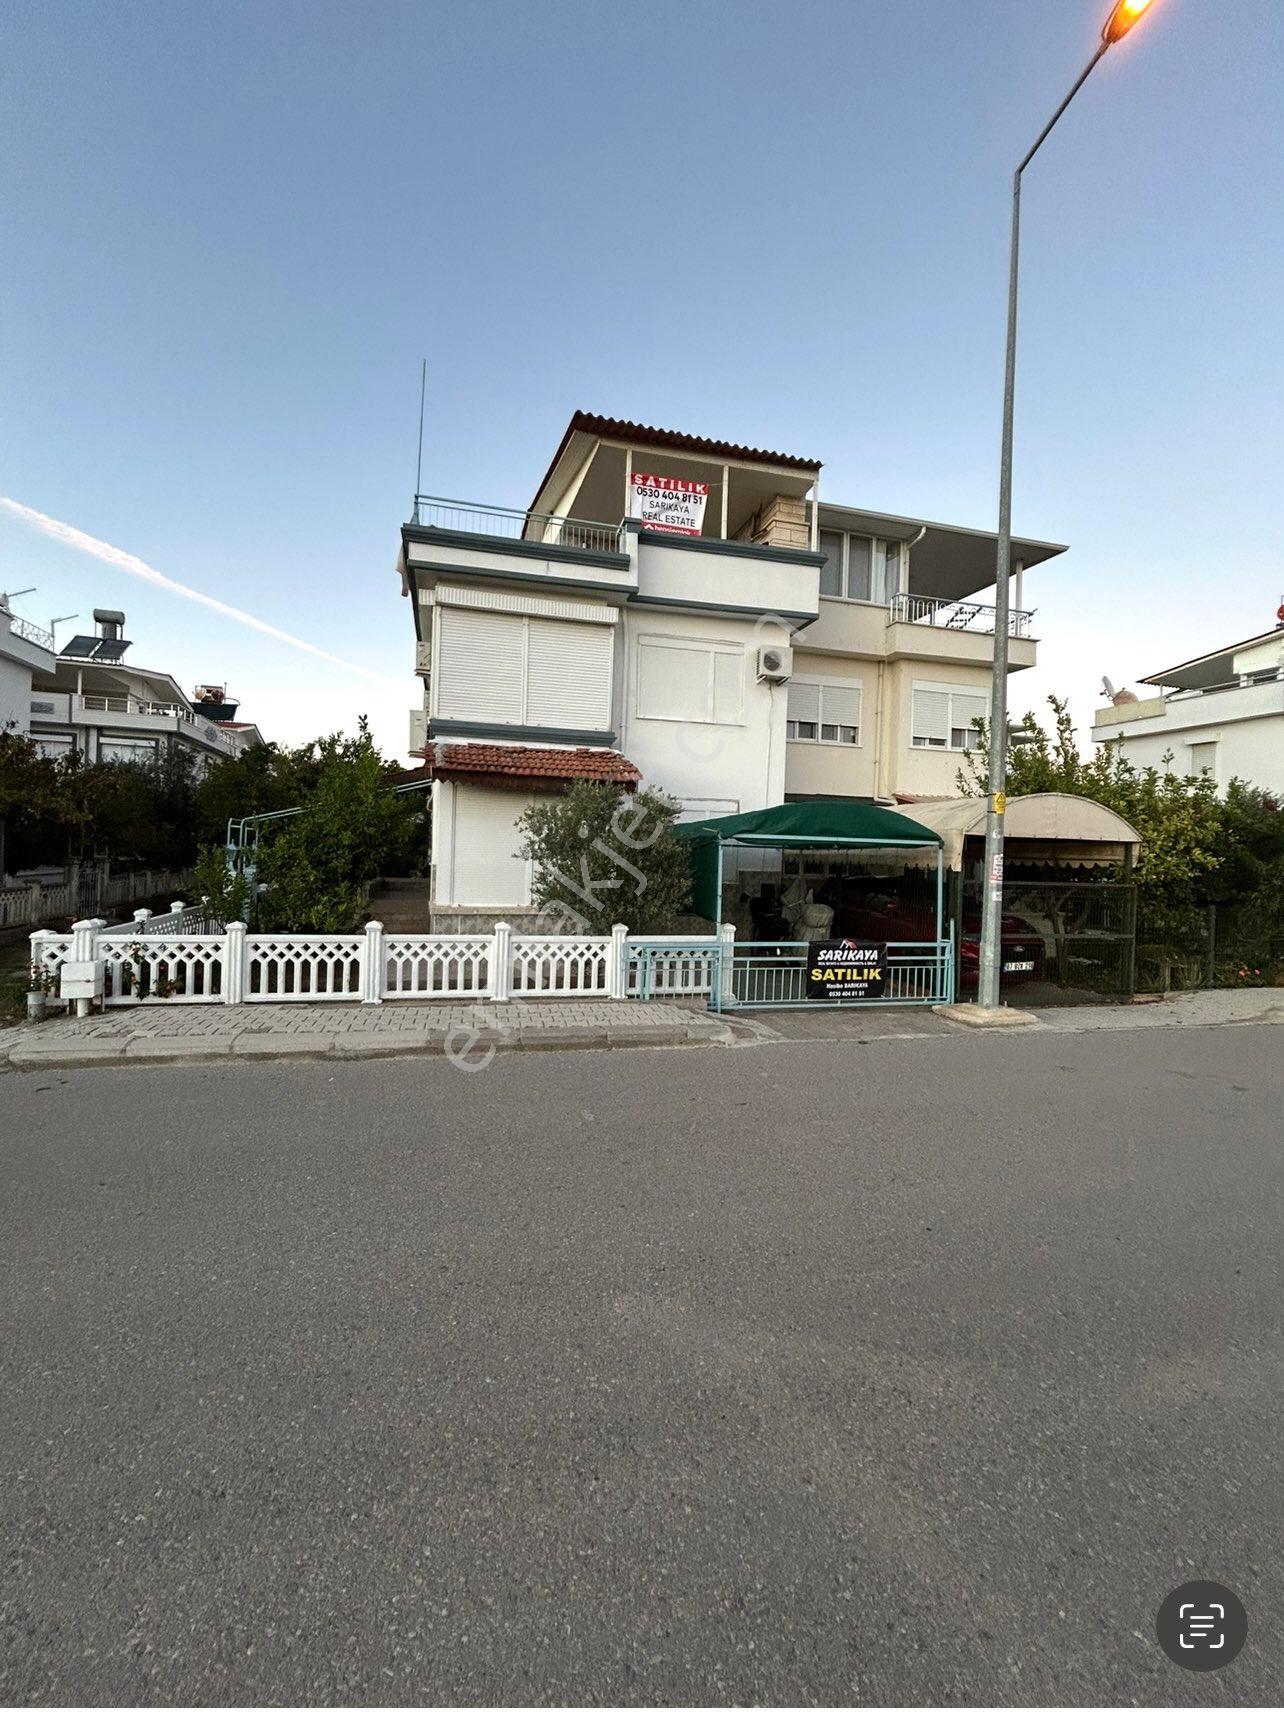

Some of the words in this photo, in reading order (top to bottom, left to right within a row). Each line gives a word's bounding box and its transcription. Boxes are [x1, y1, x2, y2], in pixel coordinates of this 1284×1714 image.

[634, 473, 705, 494] SATILIK
[636, 486, 660, 498] 0530
[662, 491, 680, 500] 404
[682, 493, 691, 503] 81
[693, 495, 702, 505] 51
[649, 500, 690, 514] SARIKAYA
[642, 511, 663, 522] REAL
[665, 514, 696, 528] ESTATE
[817, 949, 878, 961] SARIKAYA
[811, 968, 882, 981] SATILIK
